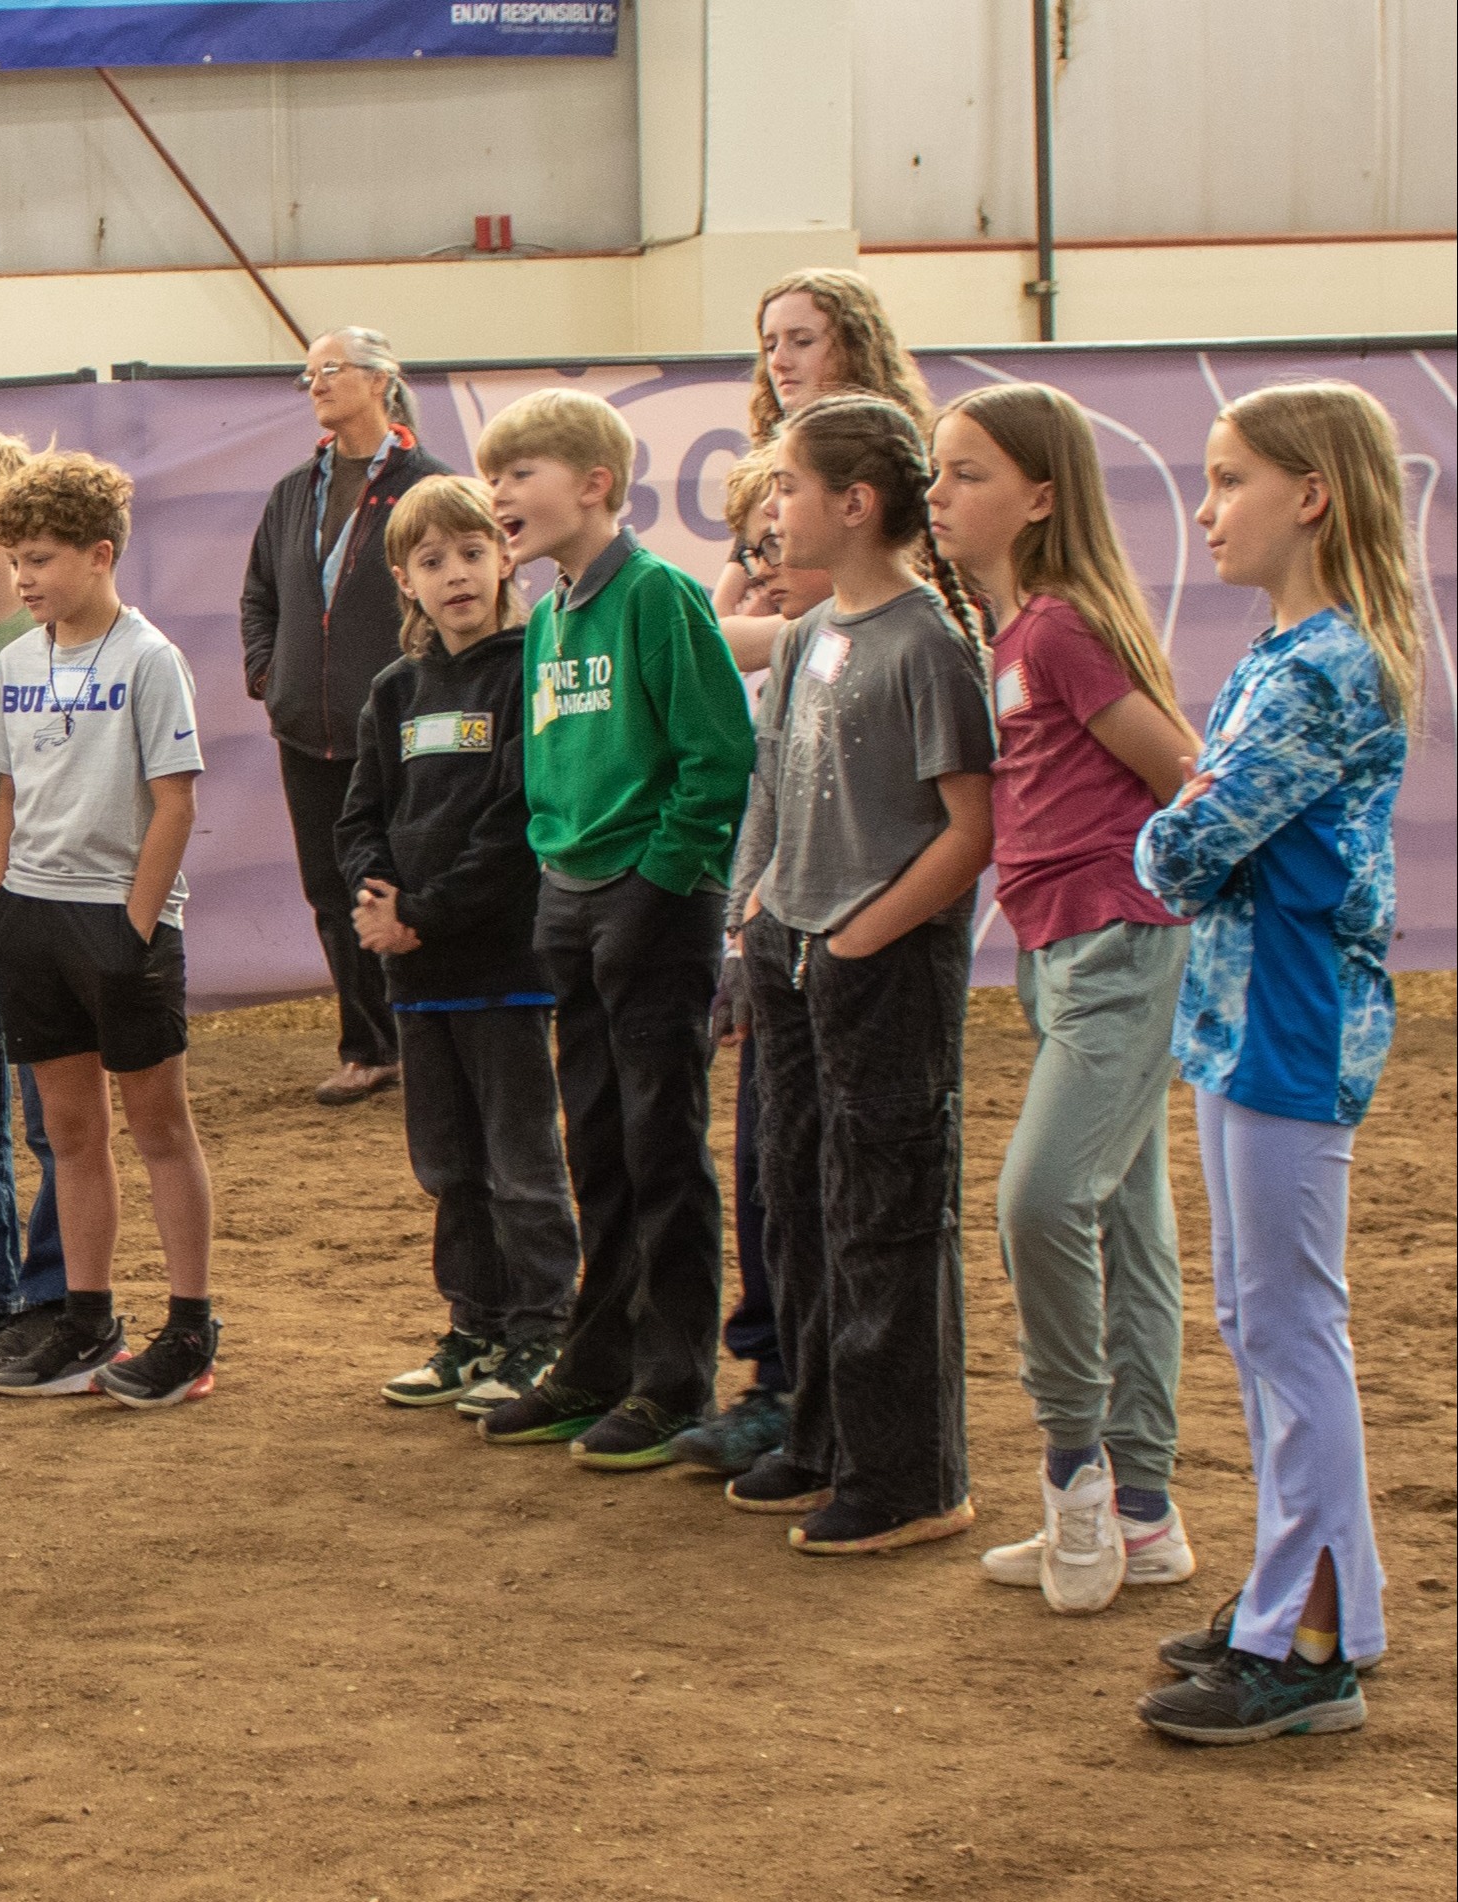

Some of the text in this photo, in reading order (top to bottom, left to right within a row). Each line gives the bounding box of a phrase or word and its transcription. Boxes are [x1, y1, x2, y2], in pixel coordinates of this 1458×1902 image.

[451, 3, 498, 25] ENJOY
[500, 3, 597, 24] RESPONSIBLY
[585, 655, 612, 686] TO
[3, 683, 126, 713] BULO
